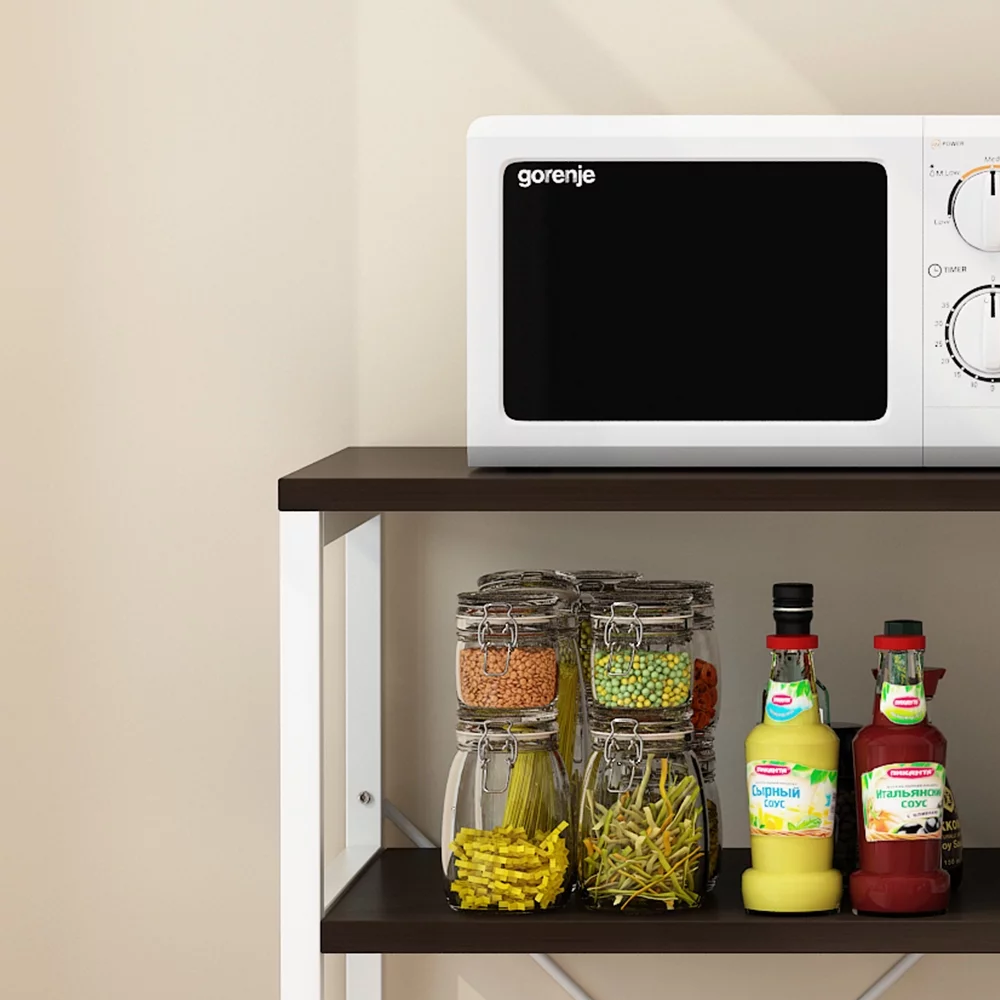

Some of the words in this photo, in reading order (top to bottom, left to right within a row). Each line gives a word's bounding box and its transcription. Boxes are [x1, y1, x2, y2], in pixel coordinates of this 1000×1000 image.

[517, 164, 596, 188] gorenje
[944, 266, 967, 274] TIMER
[890, 769, 932, 777] ПИКАНТА
[752, 784, 800, 799] Сырный
